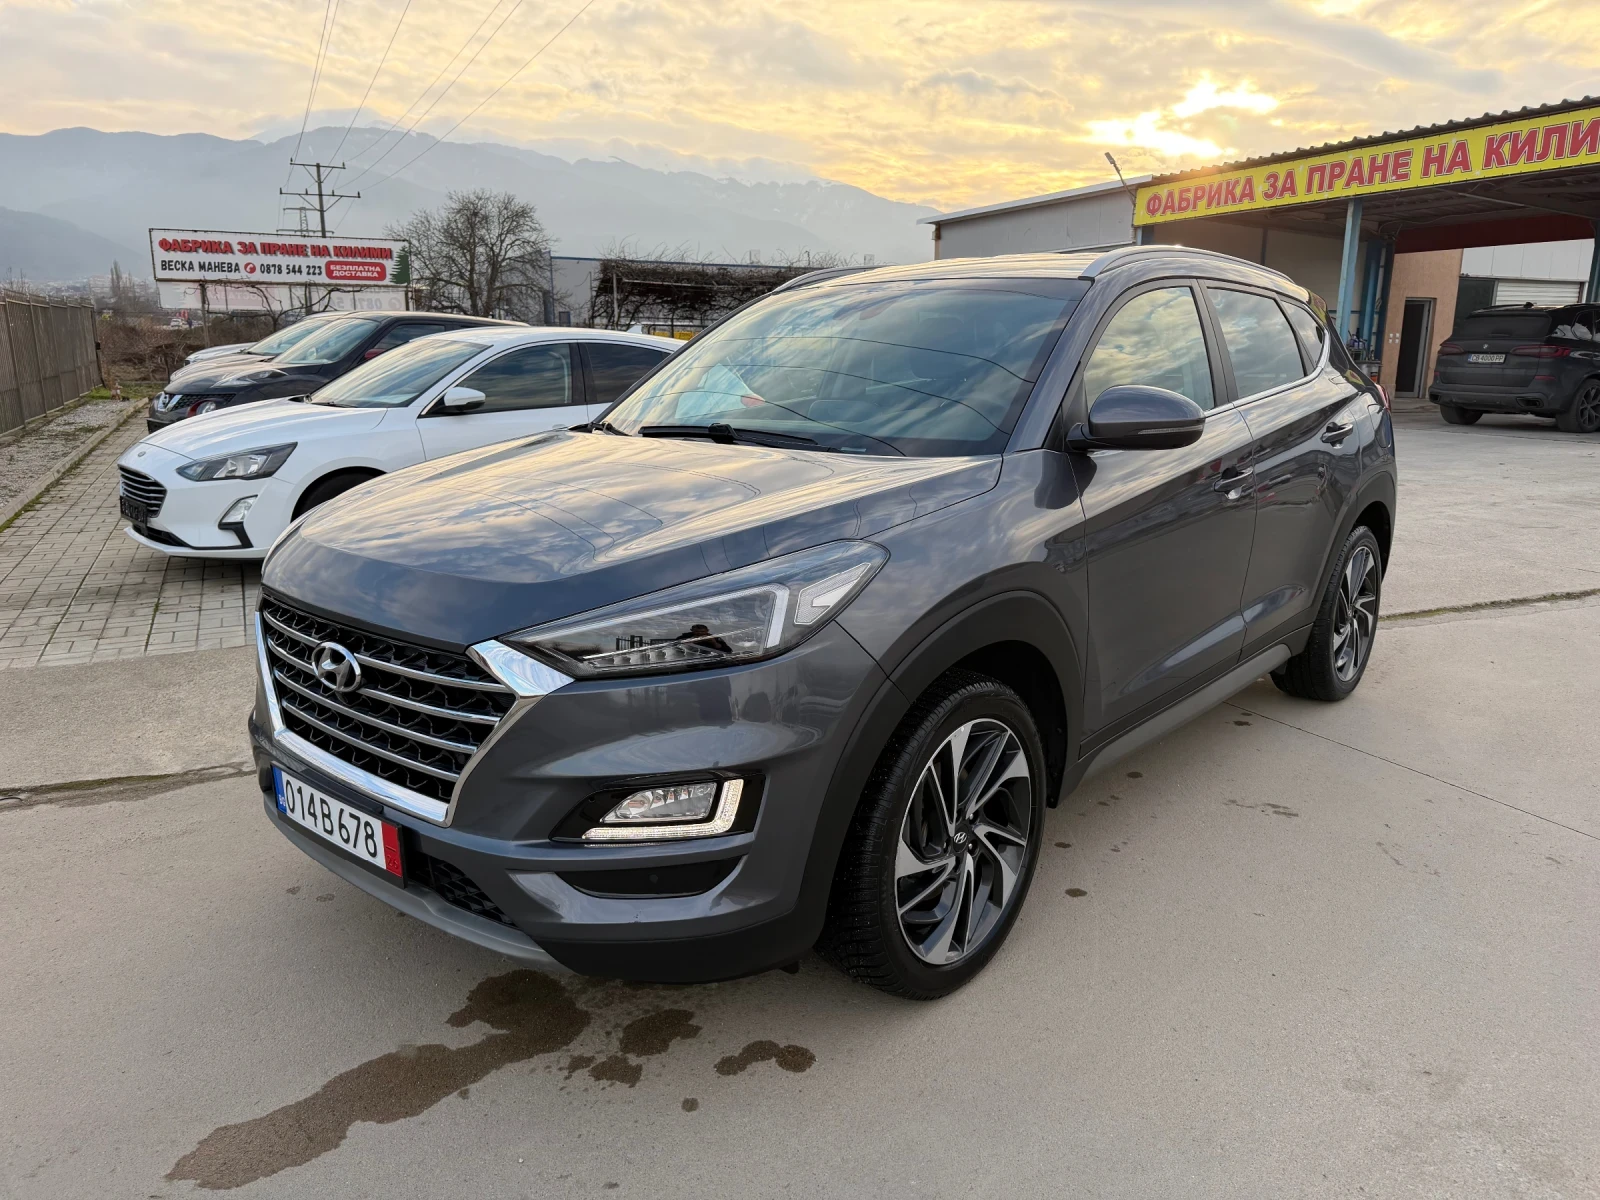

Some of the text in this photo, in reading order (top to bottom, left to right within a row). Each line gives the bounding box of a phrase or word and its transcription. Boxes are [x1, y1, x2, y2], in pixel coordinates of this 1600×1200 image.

[1146, 117, 1600, 216] ФАБРИКА ЗА ПРАНЕ НА КИЛИ
[158, 238, 393, 260] ФАБРИКА ЗА ПРАНЕ НА КИЛИМИ
[160, 260, 323, 276] ВЕСКА МАНЕВА 0878 544 223
[330, 264, 381, 272] БЕЗПЛАТНА
[285, 779, 377, 858] 014B678
